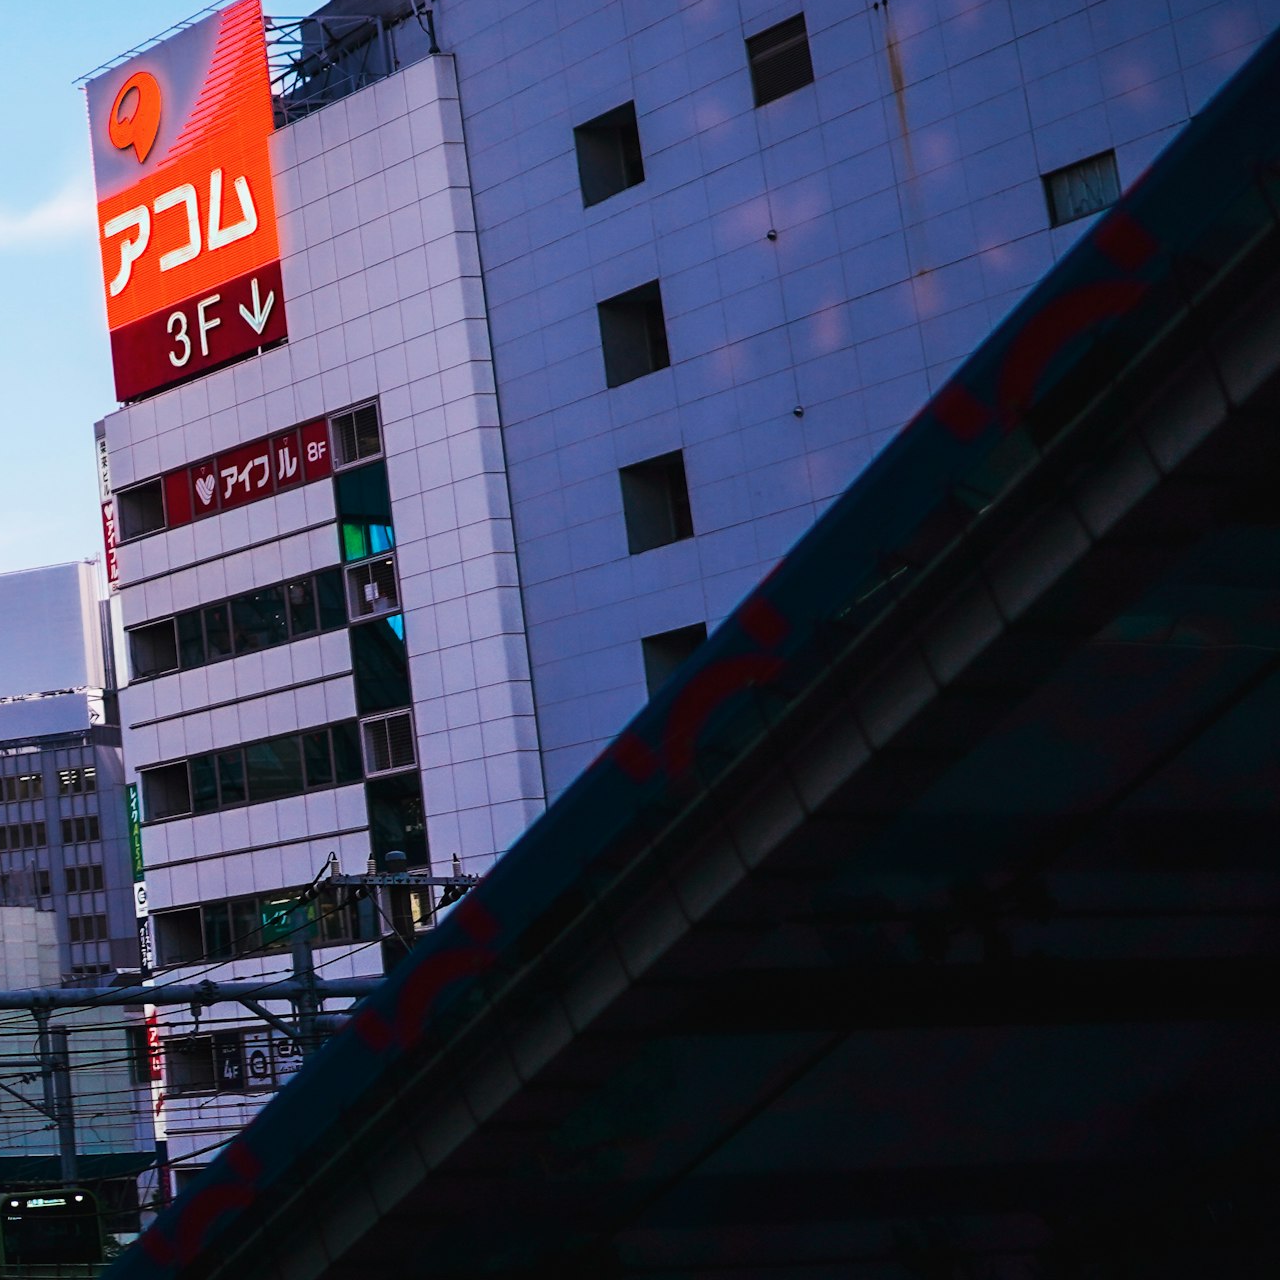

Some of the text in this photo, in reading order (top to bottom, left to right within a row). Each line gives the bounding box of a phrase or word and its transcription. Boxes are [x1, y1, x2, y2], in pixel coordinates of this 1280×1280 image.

[104, 167, 259, 298] アコム
[166, 293, 222, 368] 3F
[220, 440, 327, 500] アイフル 8F
[106, 520, 119, 580] アイフル
